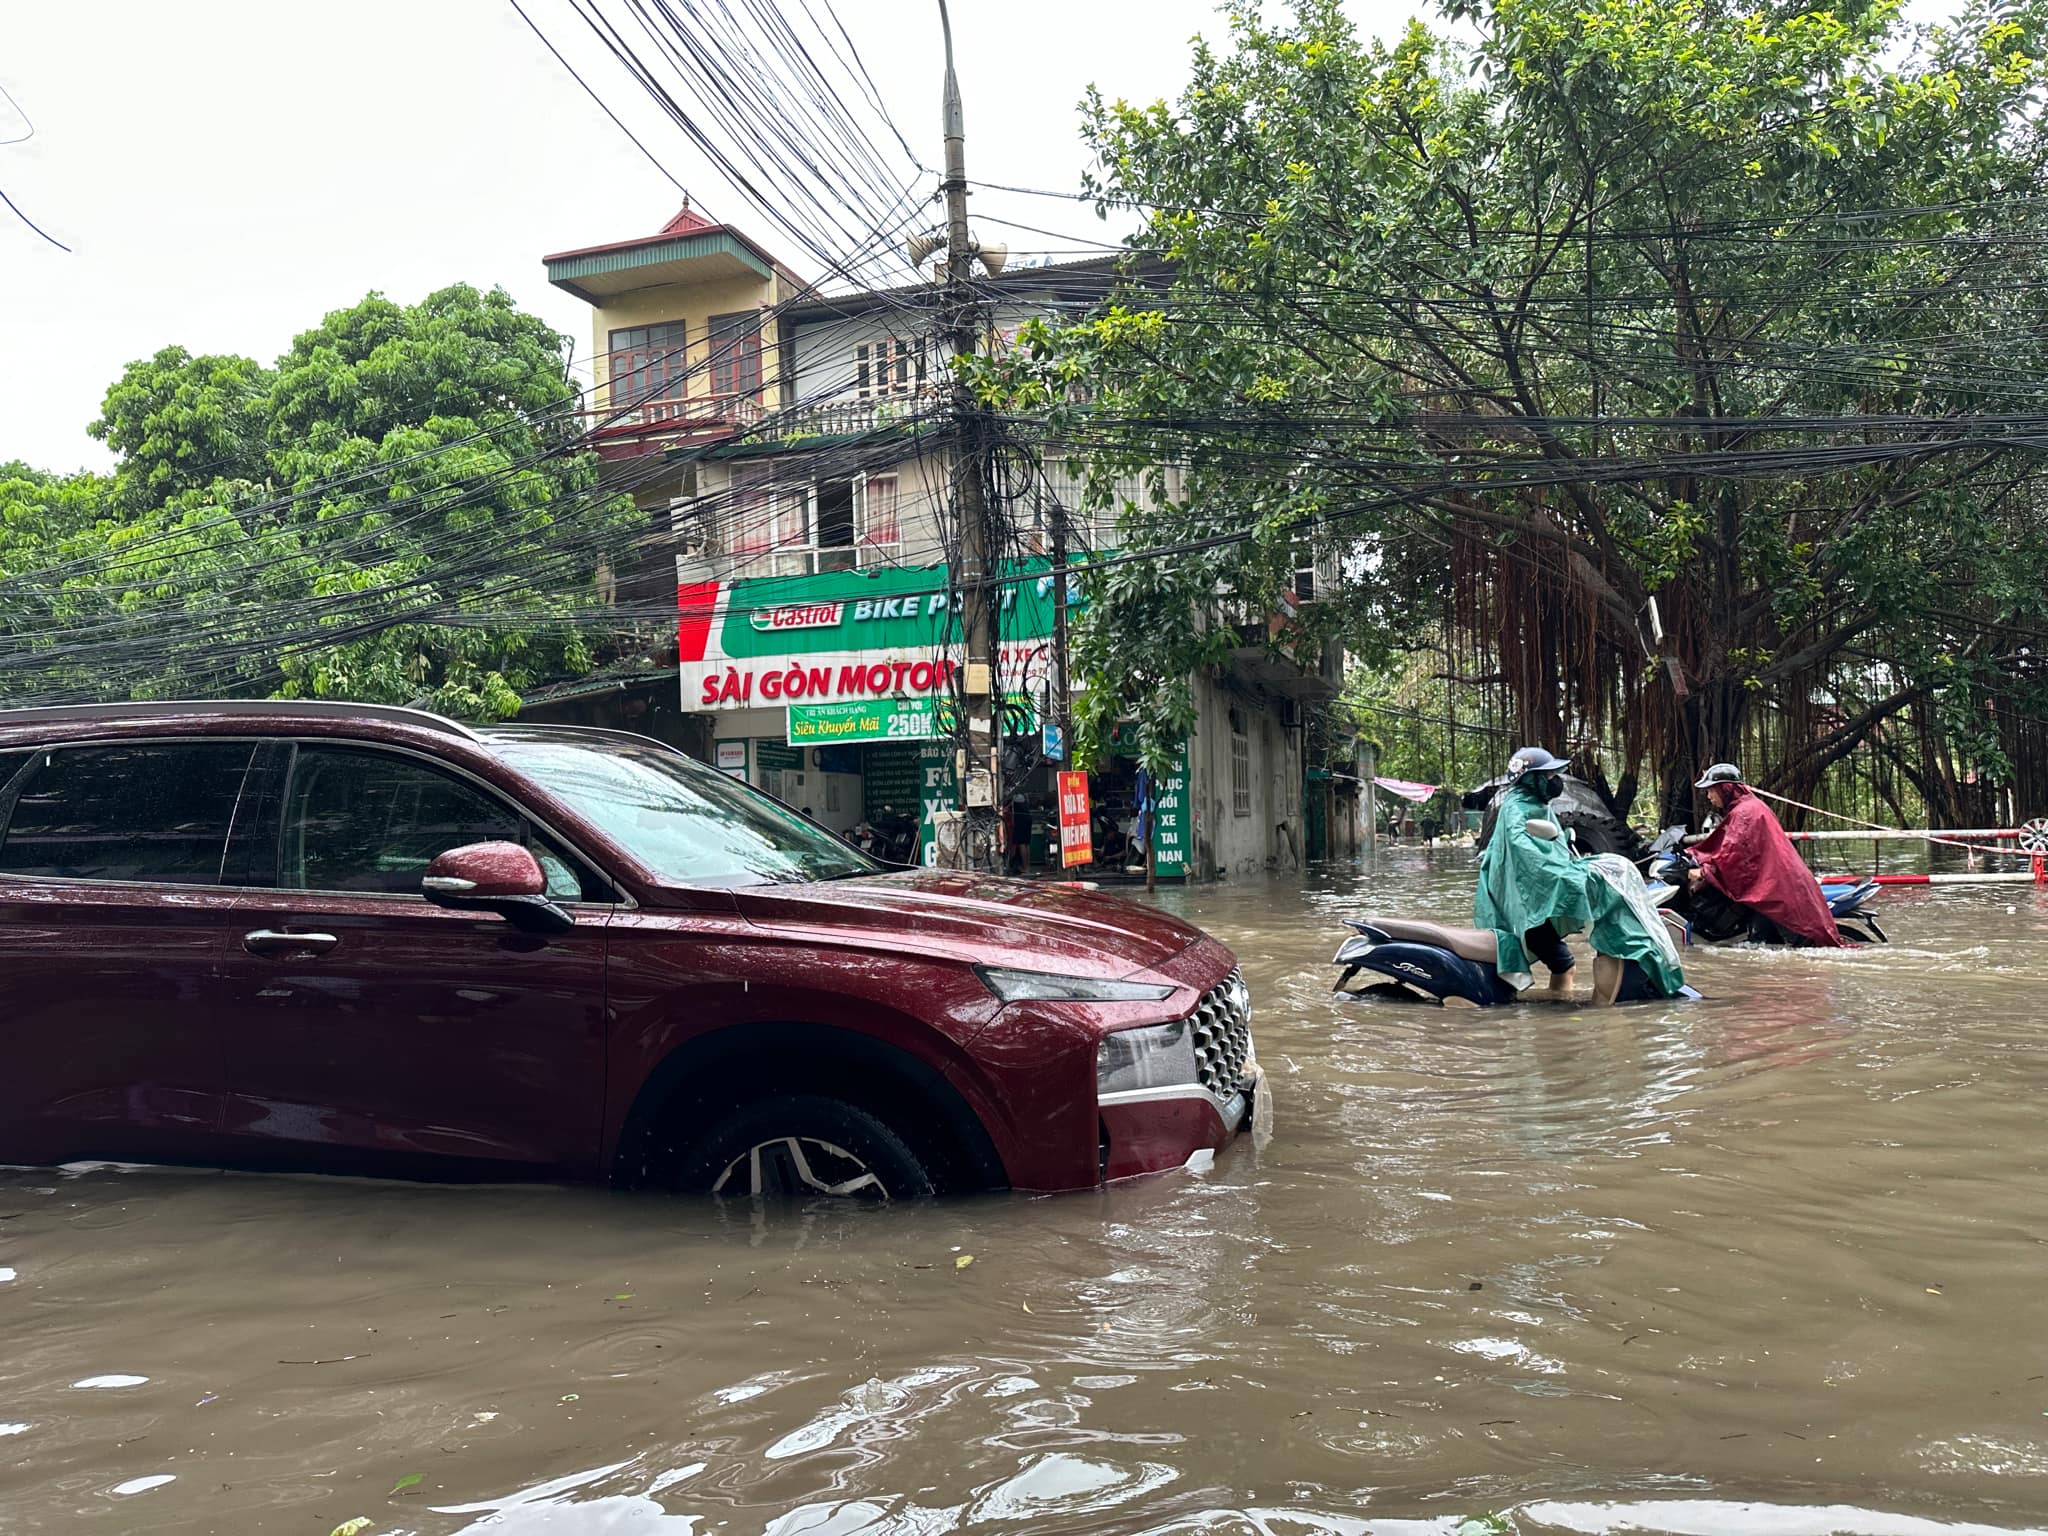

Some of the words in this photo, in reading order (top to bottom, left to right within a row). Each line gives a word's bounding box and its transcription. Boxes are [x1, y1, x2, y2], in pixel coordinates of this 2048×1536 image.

[772, 602, 838, 627] Castrol
[854, 596, 921, 621] BIKE
[701, 666, 753, 704] SÀI
[759, 662, 832, 700] GÒN
[836, 660, 957, 695] MOTOR
[793, 720, 815, 736] Siêu
[817, 716, 857, 737] Khuyến
[859, 716, 880, 732] Mãi
[887, 712, 932, 737] 250K
[1161, 814, 1177, 827] XE
[1160, 832, 1178, 845] TAI
[1157, 850, 1183, 865] NẠN
